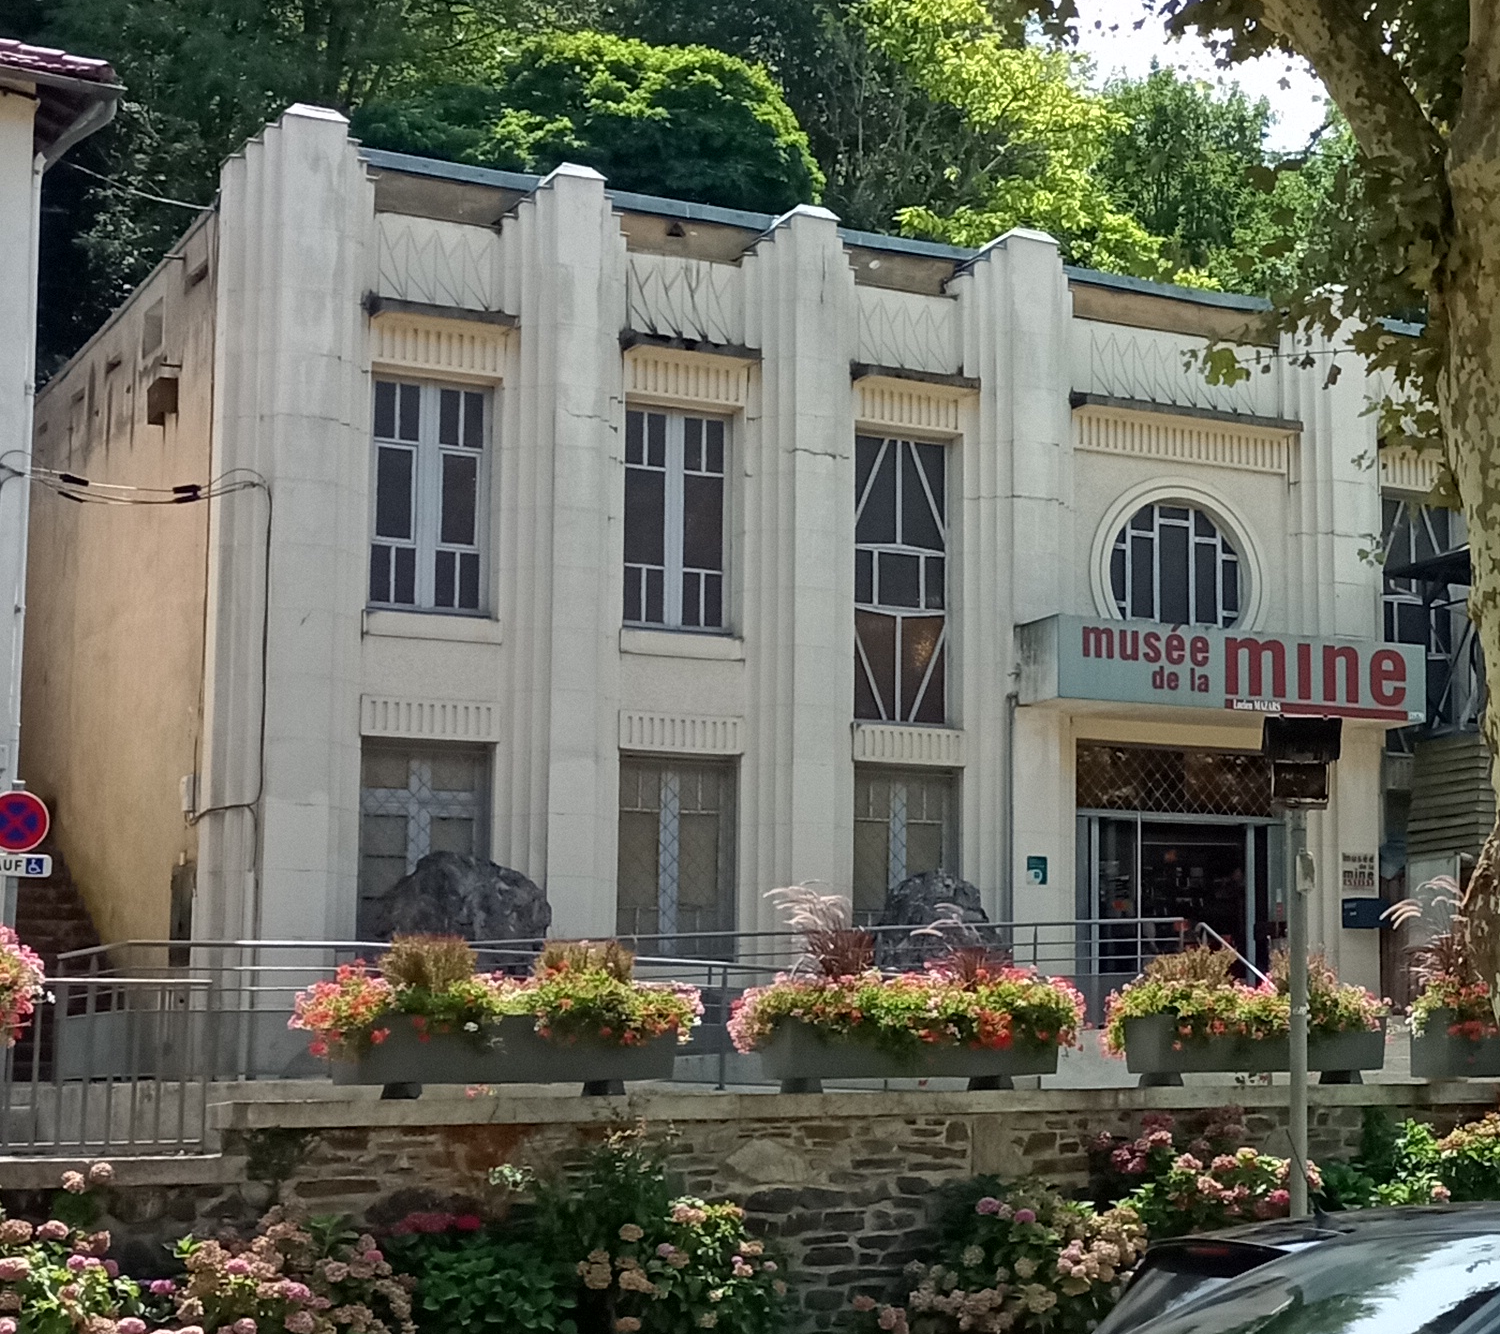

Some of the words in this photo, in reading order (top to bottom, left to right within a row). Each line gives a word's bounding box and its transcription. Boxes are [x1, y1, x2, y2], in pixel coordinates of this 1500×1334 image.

[1082, 623, 1210, 667] musée
[1152, 665, 1179, 691] de
[1190, 668, 1210, 693] la
[1225, 636, 1406, 707] mine
[1343, 868, 1374, 880] mine
